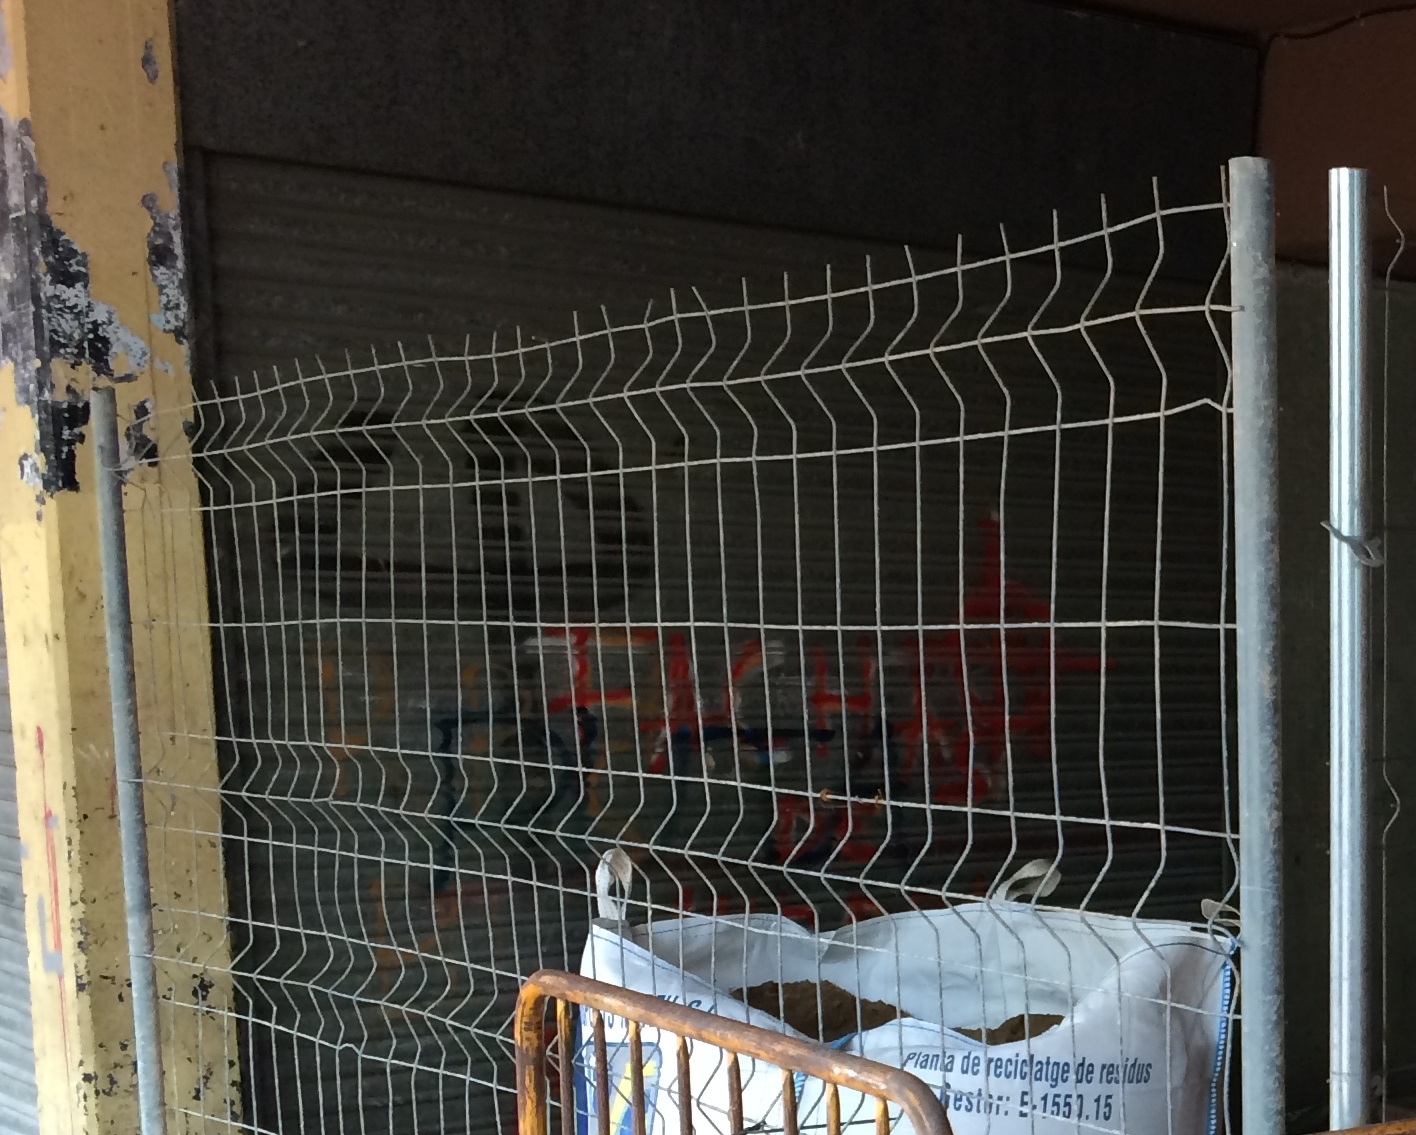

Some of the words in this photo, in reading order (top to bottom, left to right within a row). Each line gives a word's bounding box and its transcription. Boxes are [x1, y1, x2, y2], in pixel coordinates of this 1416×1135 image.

[903, 1051, 954, 1072] Planta
[961, 1051, 981, 1076] de
[988, 1053, 1069, 1089] reciclatge
[1076, 1057, 1095, 1084] de
[1099, 1057, 1153, 1084] residus
